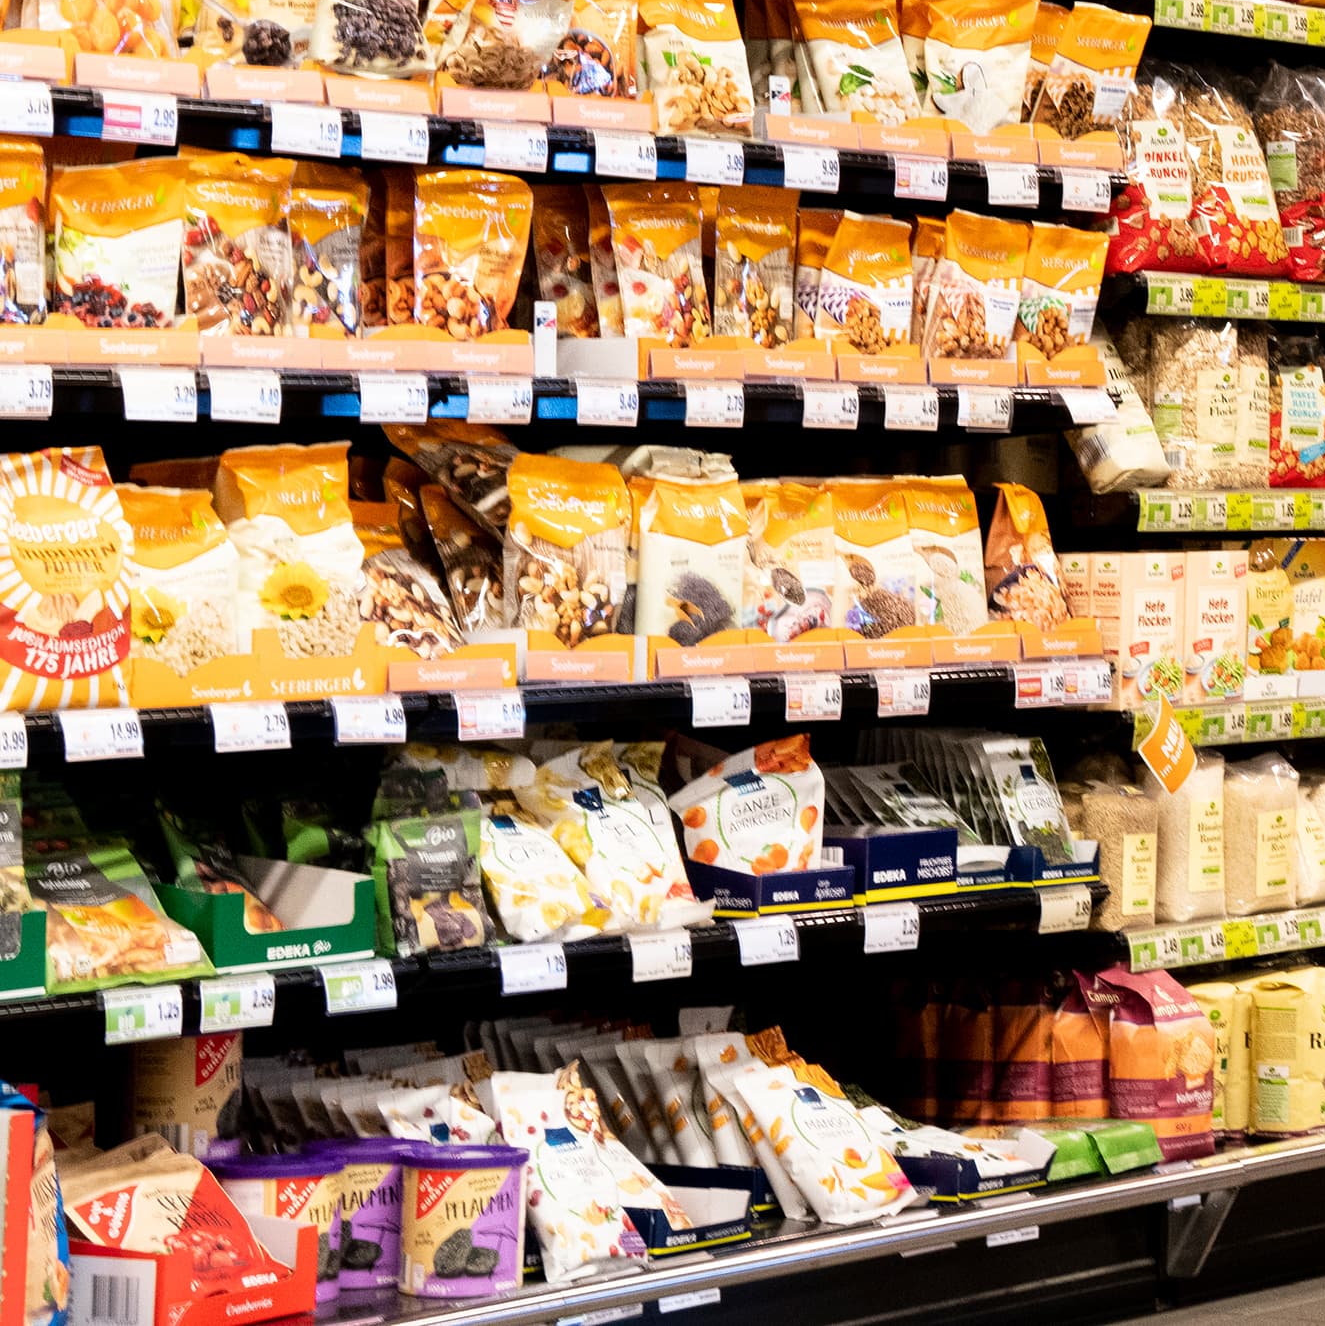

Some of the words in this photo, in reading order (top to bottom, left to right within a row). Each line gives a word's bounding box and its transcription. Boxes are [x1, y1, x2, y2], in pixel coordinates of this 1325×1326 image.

[1145, 166, 1189, 181] RUNCHY
[1296, 590, 1322, 604] alafel
[731, 794, 780, 818] GANZE
[267, 943, 311, 961] EDEKA
[340, 1181, 398, 1212] LAUMEN
